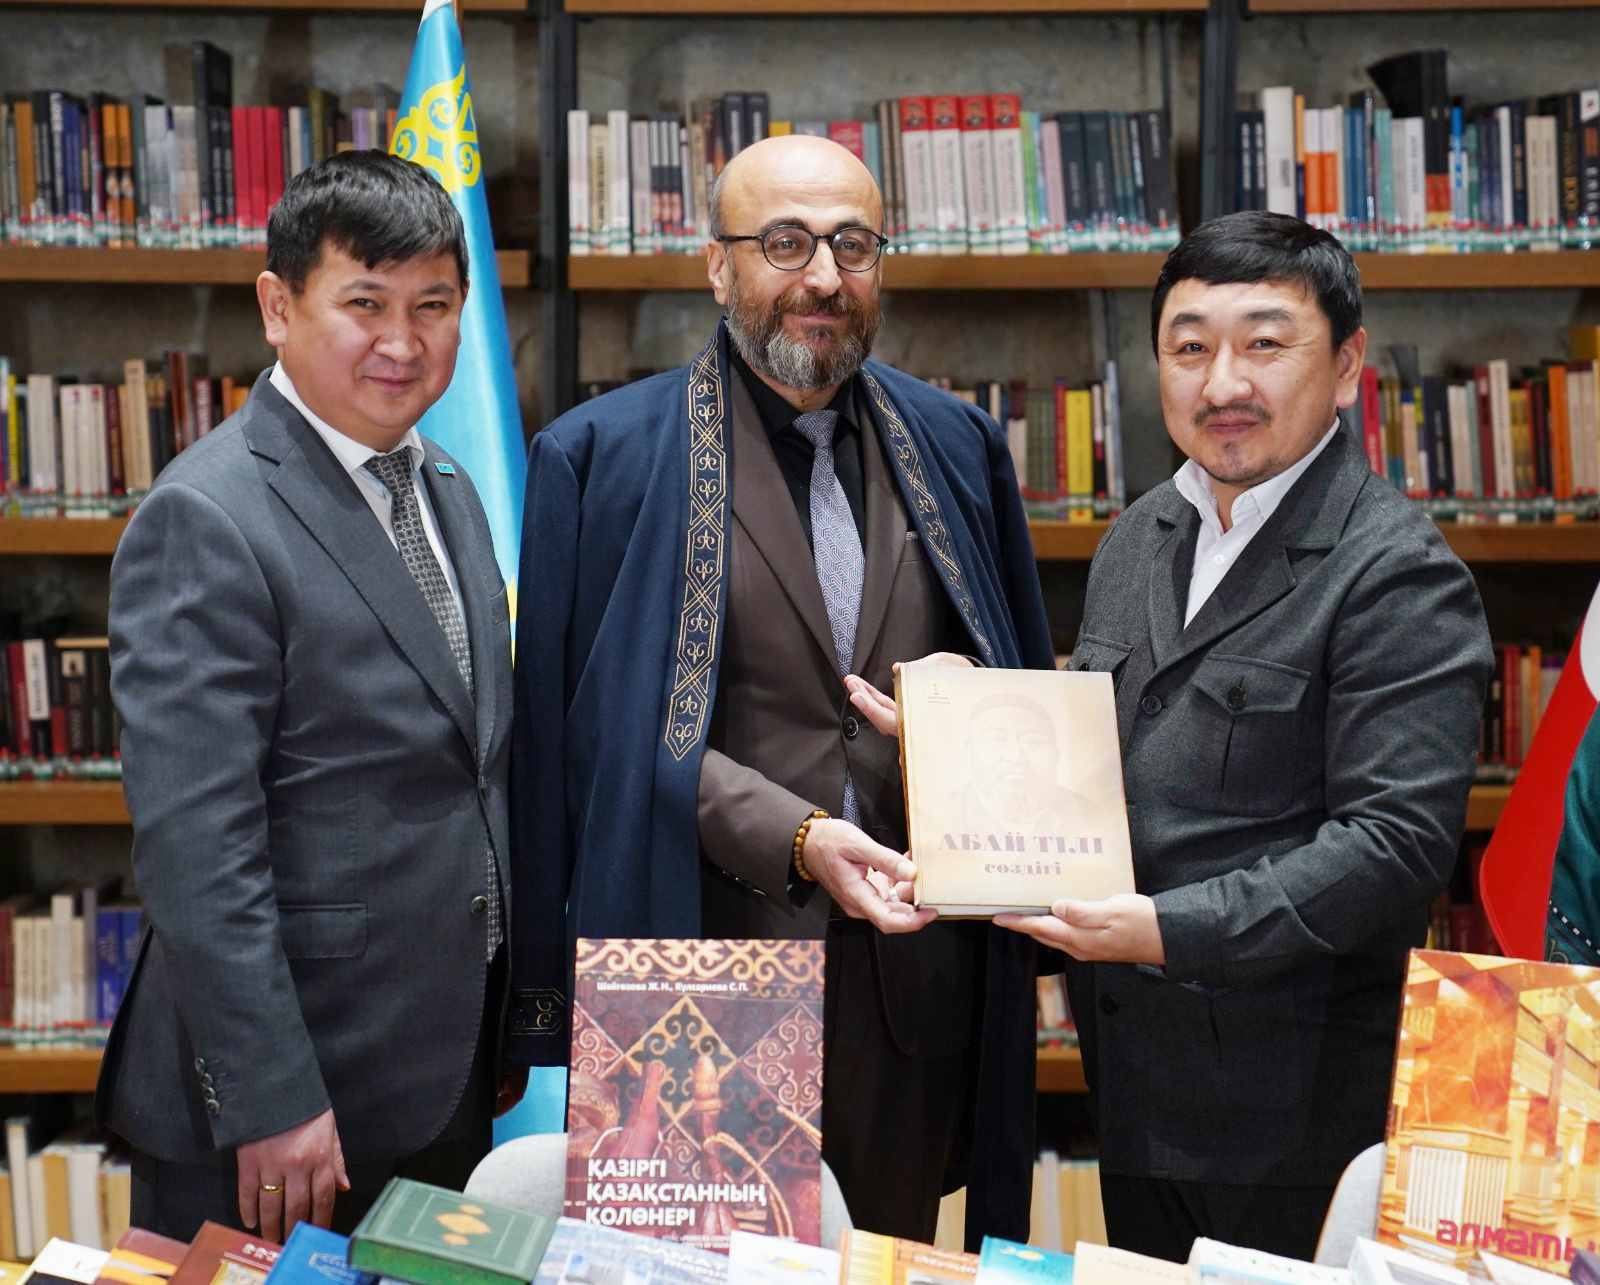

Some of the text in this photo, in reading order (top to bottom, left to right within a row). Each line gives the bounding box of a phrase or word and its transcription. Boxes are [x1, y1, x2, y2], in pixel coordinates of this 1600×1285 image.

[939, 832, 1104, 855] АБАЙ ТІЛІ
[984, 861, 1062, 876] сөздігі
[588, 1158, 667, 1180] ҚАЗІРГІ
[586, 1181, 768, 1207] ҚАЗАҚСТАННЫҢ
[585, 1206, 696, 1228] ҚОЛӨНЕРІ
